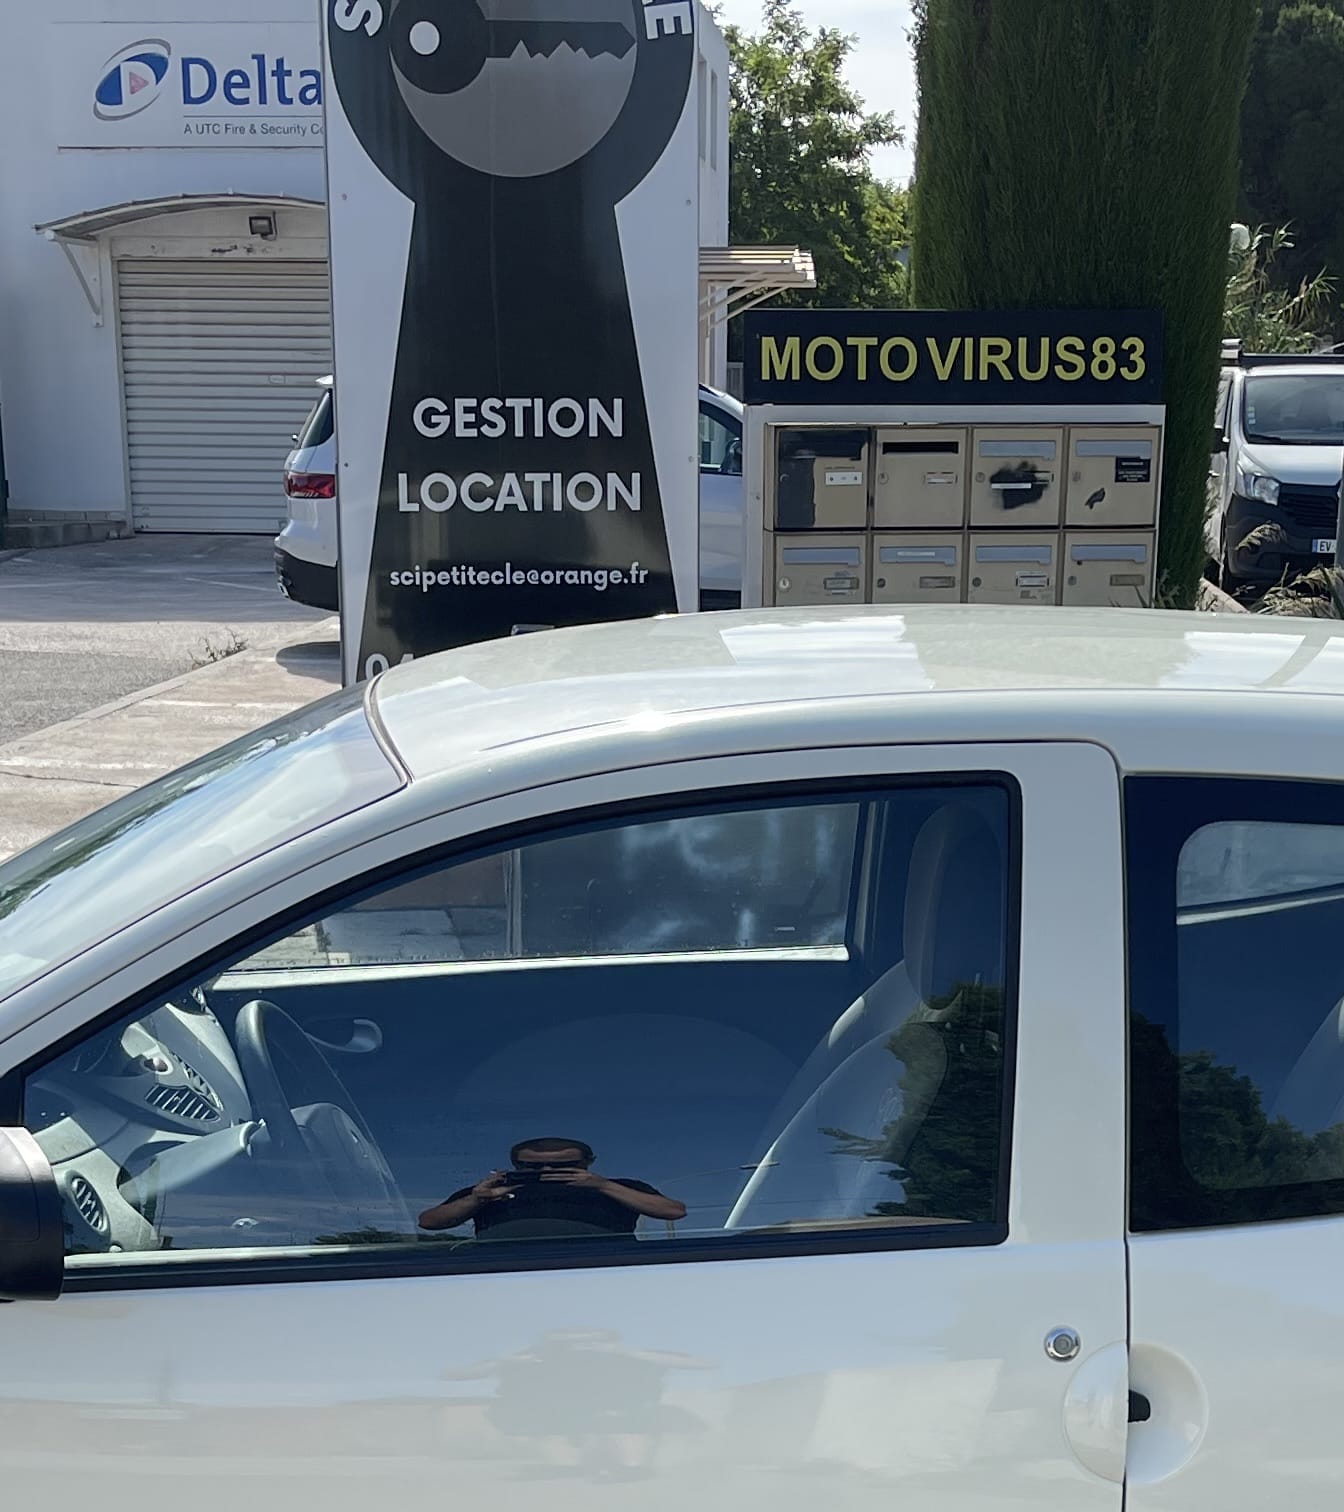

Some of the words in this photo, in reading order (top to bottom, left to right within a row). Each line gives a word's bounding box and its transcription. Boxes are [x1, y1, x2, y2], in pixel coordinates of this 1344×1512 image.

[181, 53, 322, 105] Delta
[183, 123, 193, 135] A
[196, 123, 221, 135] UTC
[224, 123, 246, 135] Fire
[248, 123, 257, 135] &
[260, 122, 307, 137] Security
[761, 336, 918, 381] MOTO
[413, 397, 623, 438] GESTION
[398, 472, 641, 512] LOCATION
[390, 562, 648, 593] scipetitecle@orange.fr
